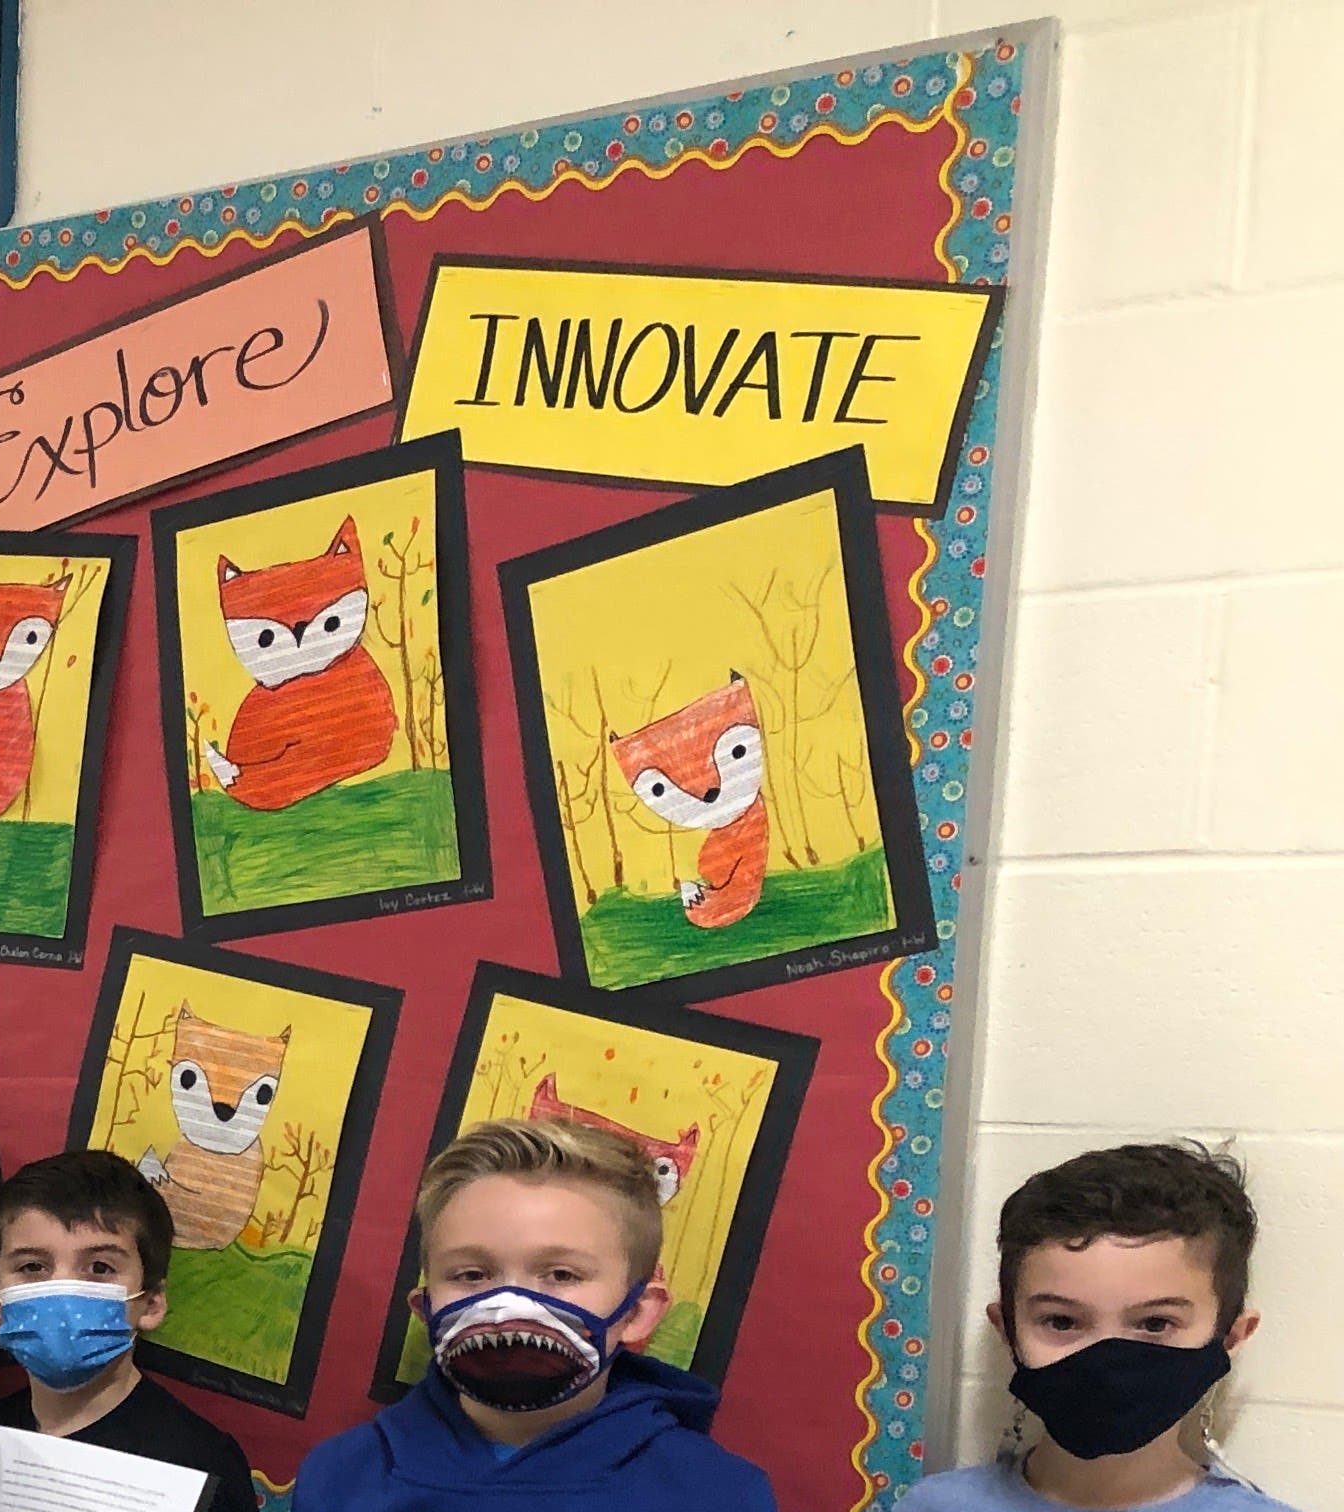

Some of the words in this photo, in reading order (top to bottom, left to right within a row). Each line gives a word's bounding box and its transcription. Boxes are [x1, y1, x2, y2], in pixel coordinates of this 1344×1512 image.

[455, 312, 921, 424] INNOVATE
[786, 958, 824, 977] Noah
[829, 945, 889, 967] Shapiro
